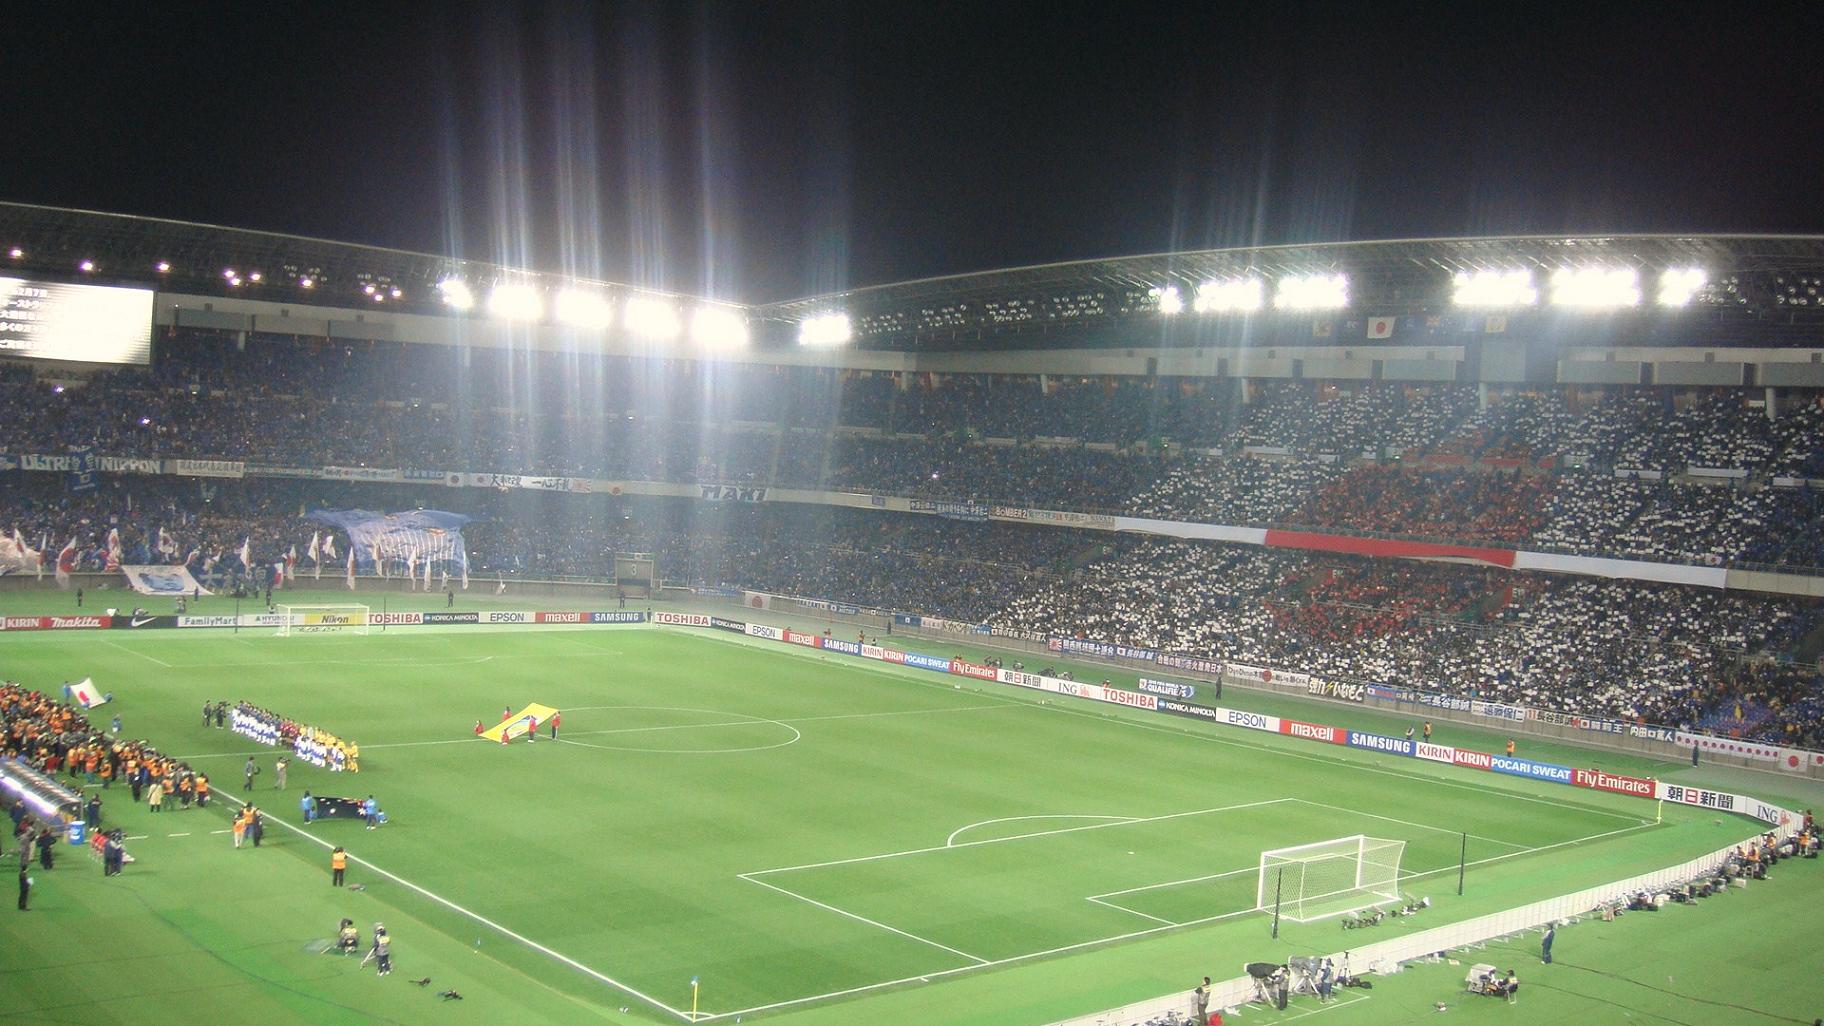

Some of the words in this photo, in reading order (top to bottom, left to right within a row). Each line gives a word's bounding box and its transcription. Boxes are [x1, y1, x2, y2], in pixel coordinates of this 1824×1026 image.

[100, 456, 161, 474] NIPPON
[7, 618, 40, 628] KIRIN
[184, 617, 237, 626] FamilyMart
[321, 615, 349, 623] Nikon
[369, 613, 421, 624] TOSHIBA
[490, 613, 524, 622] EPSON
[545, 612, 580, 622] maxell
[594, 612, 639, 622] SAMSUNG
[656, 613, 709, 625] TOSHIBA
[752, 625, 776, 638] EPSON
[789, 633, 815, 645] maxell
[824, 639, 859, 653] SAMSUNG
[863, 646, 883, 658] KIRIN
[884, 650, 904, 662] KIRIN
[904, 652, 928, 666] POCARI
[928, 657, 950, 669] SWEAT
[953, 661, 965, 674] Fly
[965, 664, 995, 678] Emirates
[1058, 682, 1078, 696] ING
[1103, 689, 1156, 708] TOSHIBA
[1166, 702, 1188, 713] KONICA
[1187, 705, 1216, 717] MINOLTA
[1228, 711, 1267, 728] EPSON
[1290, 723, 1334, 741] maxell
[1351, 733, 1411, 753] SAMSUNG
[1419, 745, 1452, 761] KIRIN
[1455, 751, 1490, 767] KIRIN
[1491, 758, 1530, 773] POCARI
[1532, 765, 1571, 779] SWEAT
[1577, 771, 1598, 788] Fly
[1598, 774, 1651, 794] Emirates
[1667, 785, 1734, 809] 朝日新聞
[1756, 805, 1779, 823] ING
